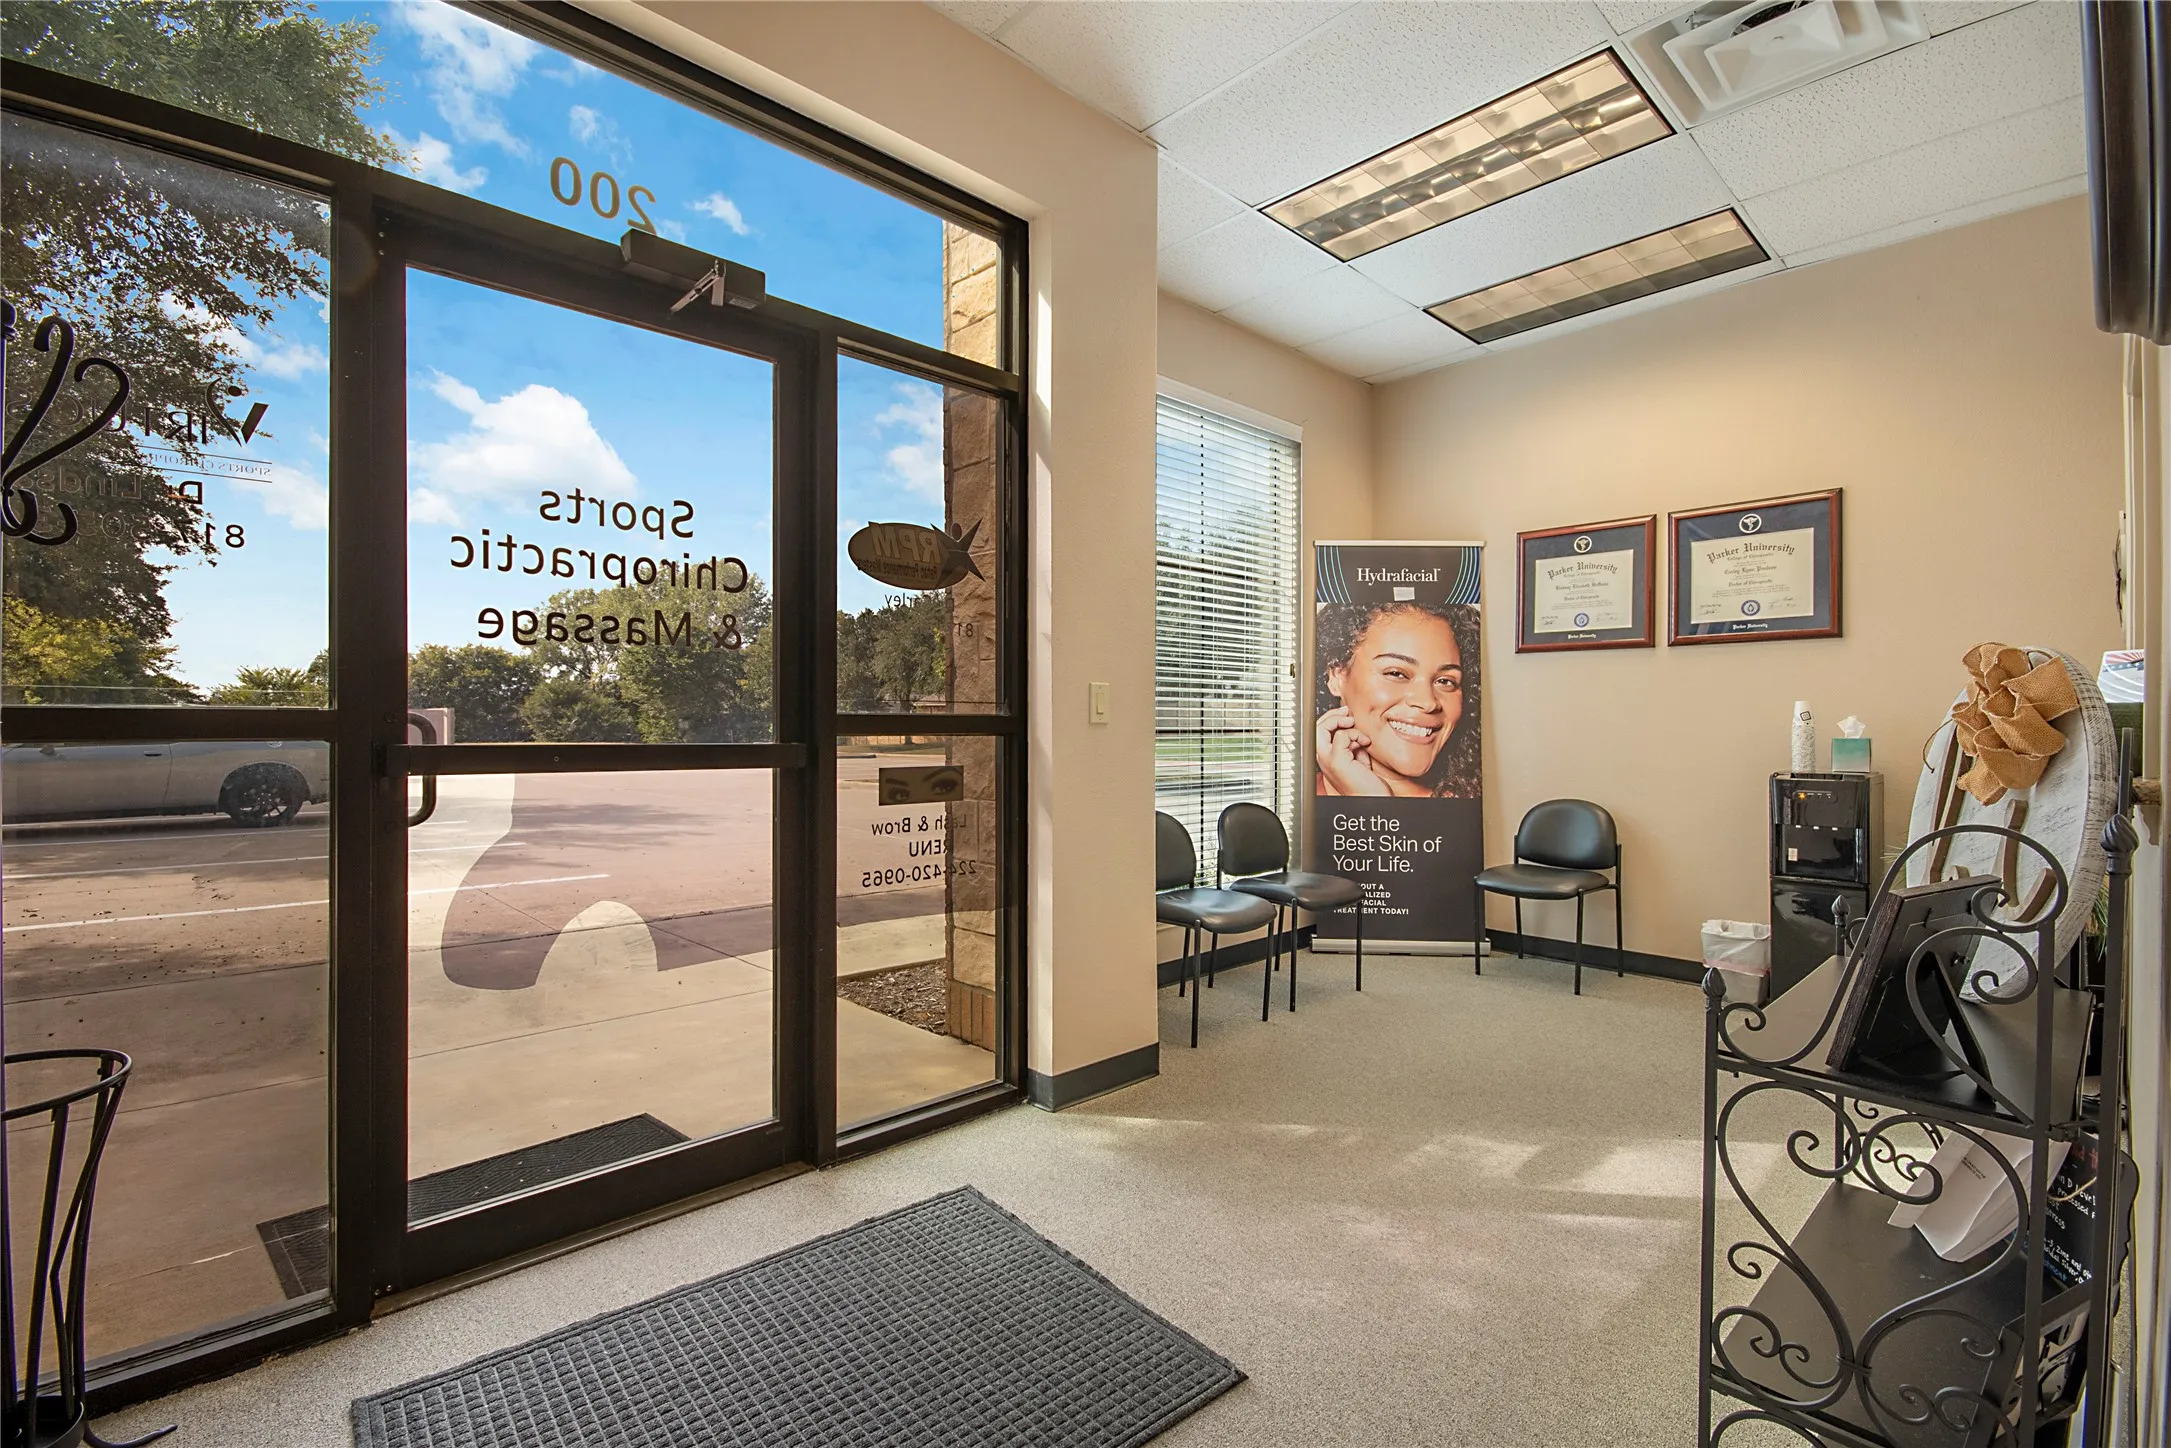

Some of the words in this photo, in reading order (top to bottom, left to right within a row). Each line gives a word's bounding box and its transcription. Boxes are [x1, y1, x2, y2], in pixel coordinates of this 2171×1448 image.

[1706, 548, 1739, 564] Parker
[1743, 543, 1795, 556] University
[1547, 565, 1574, 580] Parker
[1577, 562, 1618, 575] University
[1333, 814, 1366, 832] Get
[1370, 815, 1400, 832] the
[1333, 834, 1375, 852] Best
[1379, 835, 1418, 852] Skin
[1423, 836, 1443, 853] of
[1332, 855, 1373, 872] Your
[1378, 855, 1414, 873] Life.
[1380, 908, 1409, 916] TODAY!
